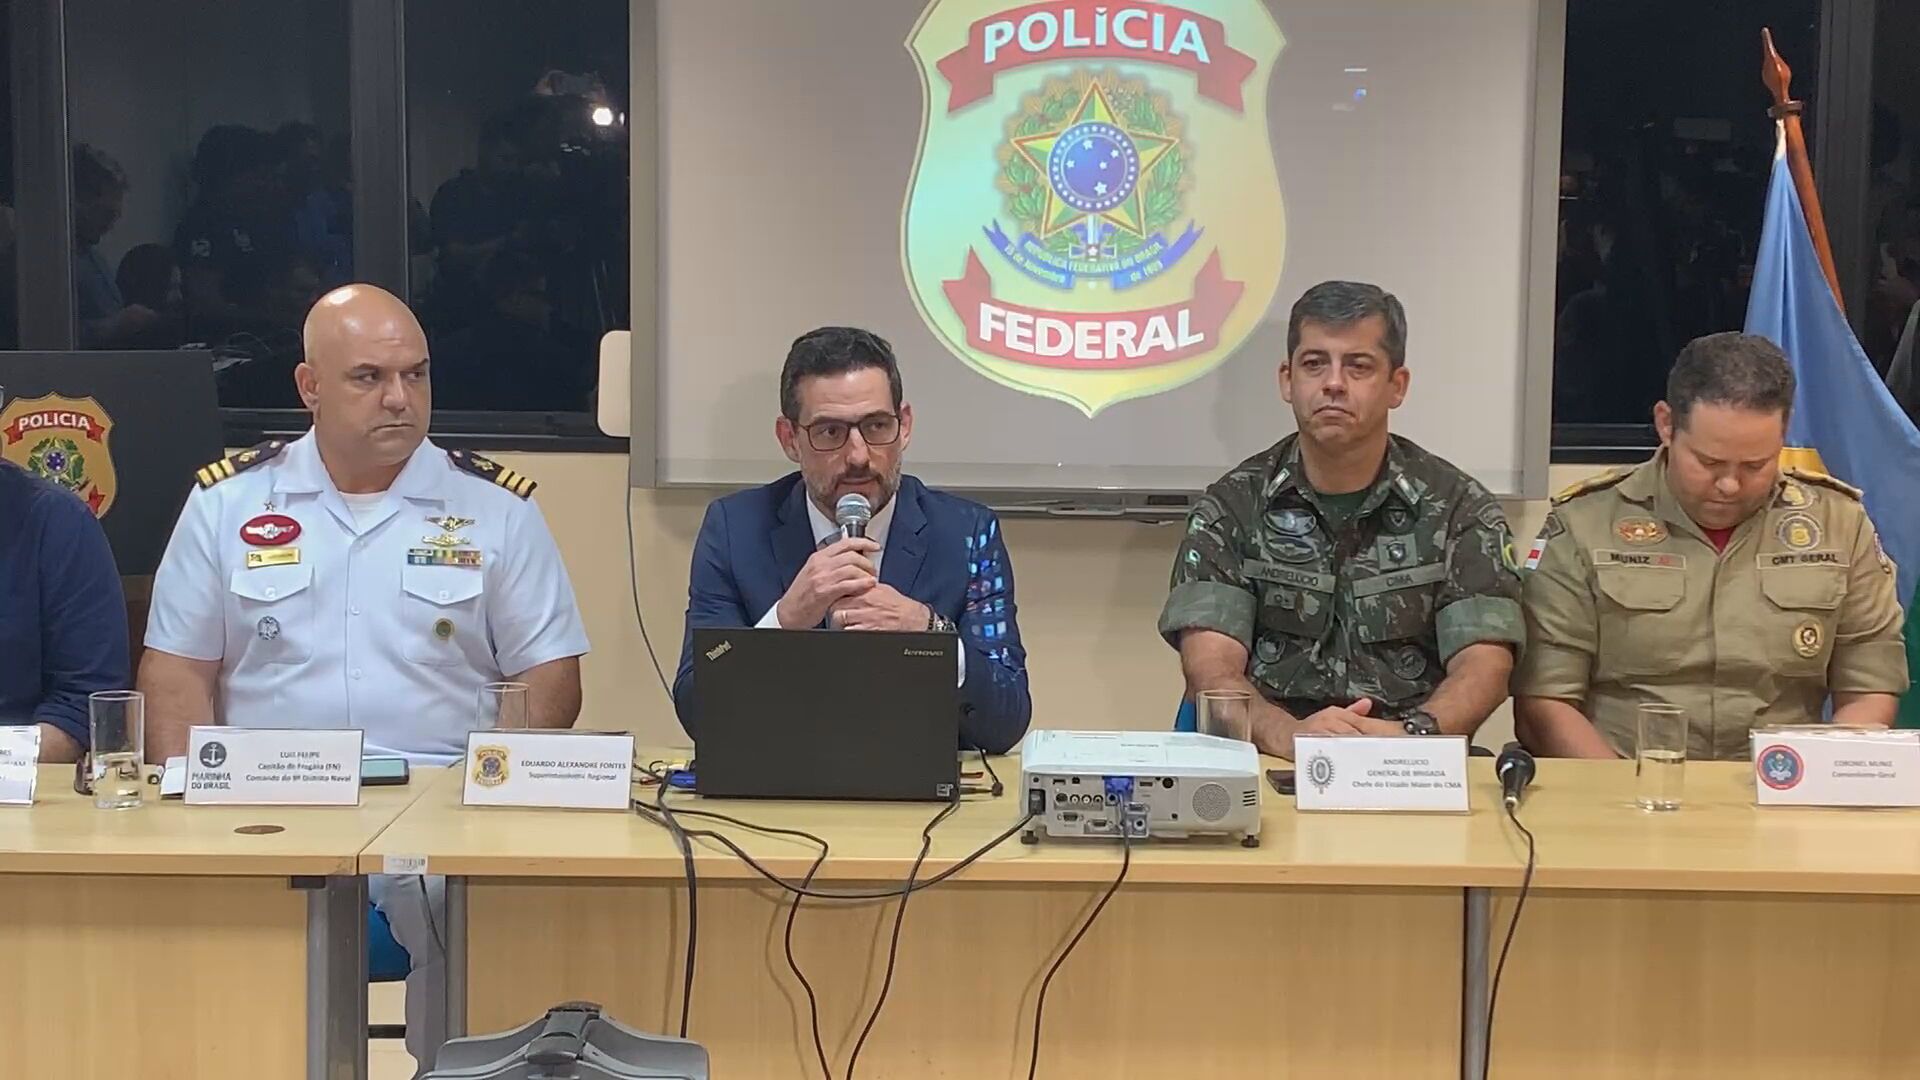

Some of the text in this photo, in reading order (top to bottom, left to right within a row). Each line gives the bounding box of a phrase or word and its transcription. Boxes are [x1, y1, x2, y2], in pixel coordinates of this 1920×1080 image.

[978, 302, 1205, 361] FEDERAL
[1610, 553, 1650, 565] MUNIZ
[520, 760, 626, 770] EDUARDO ALEXANDRE FONTES
